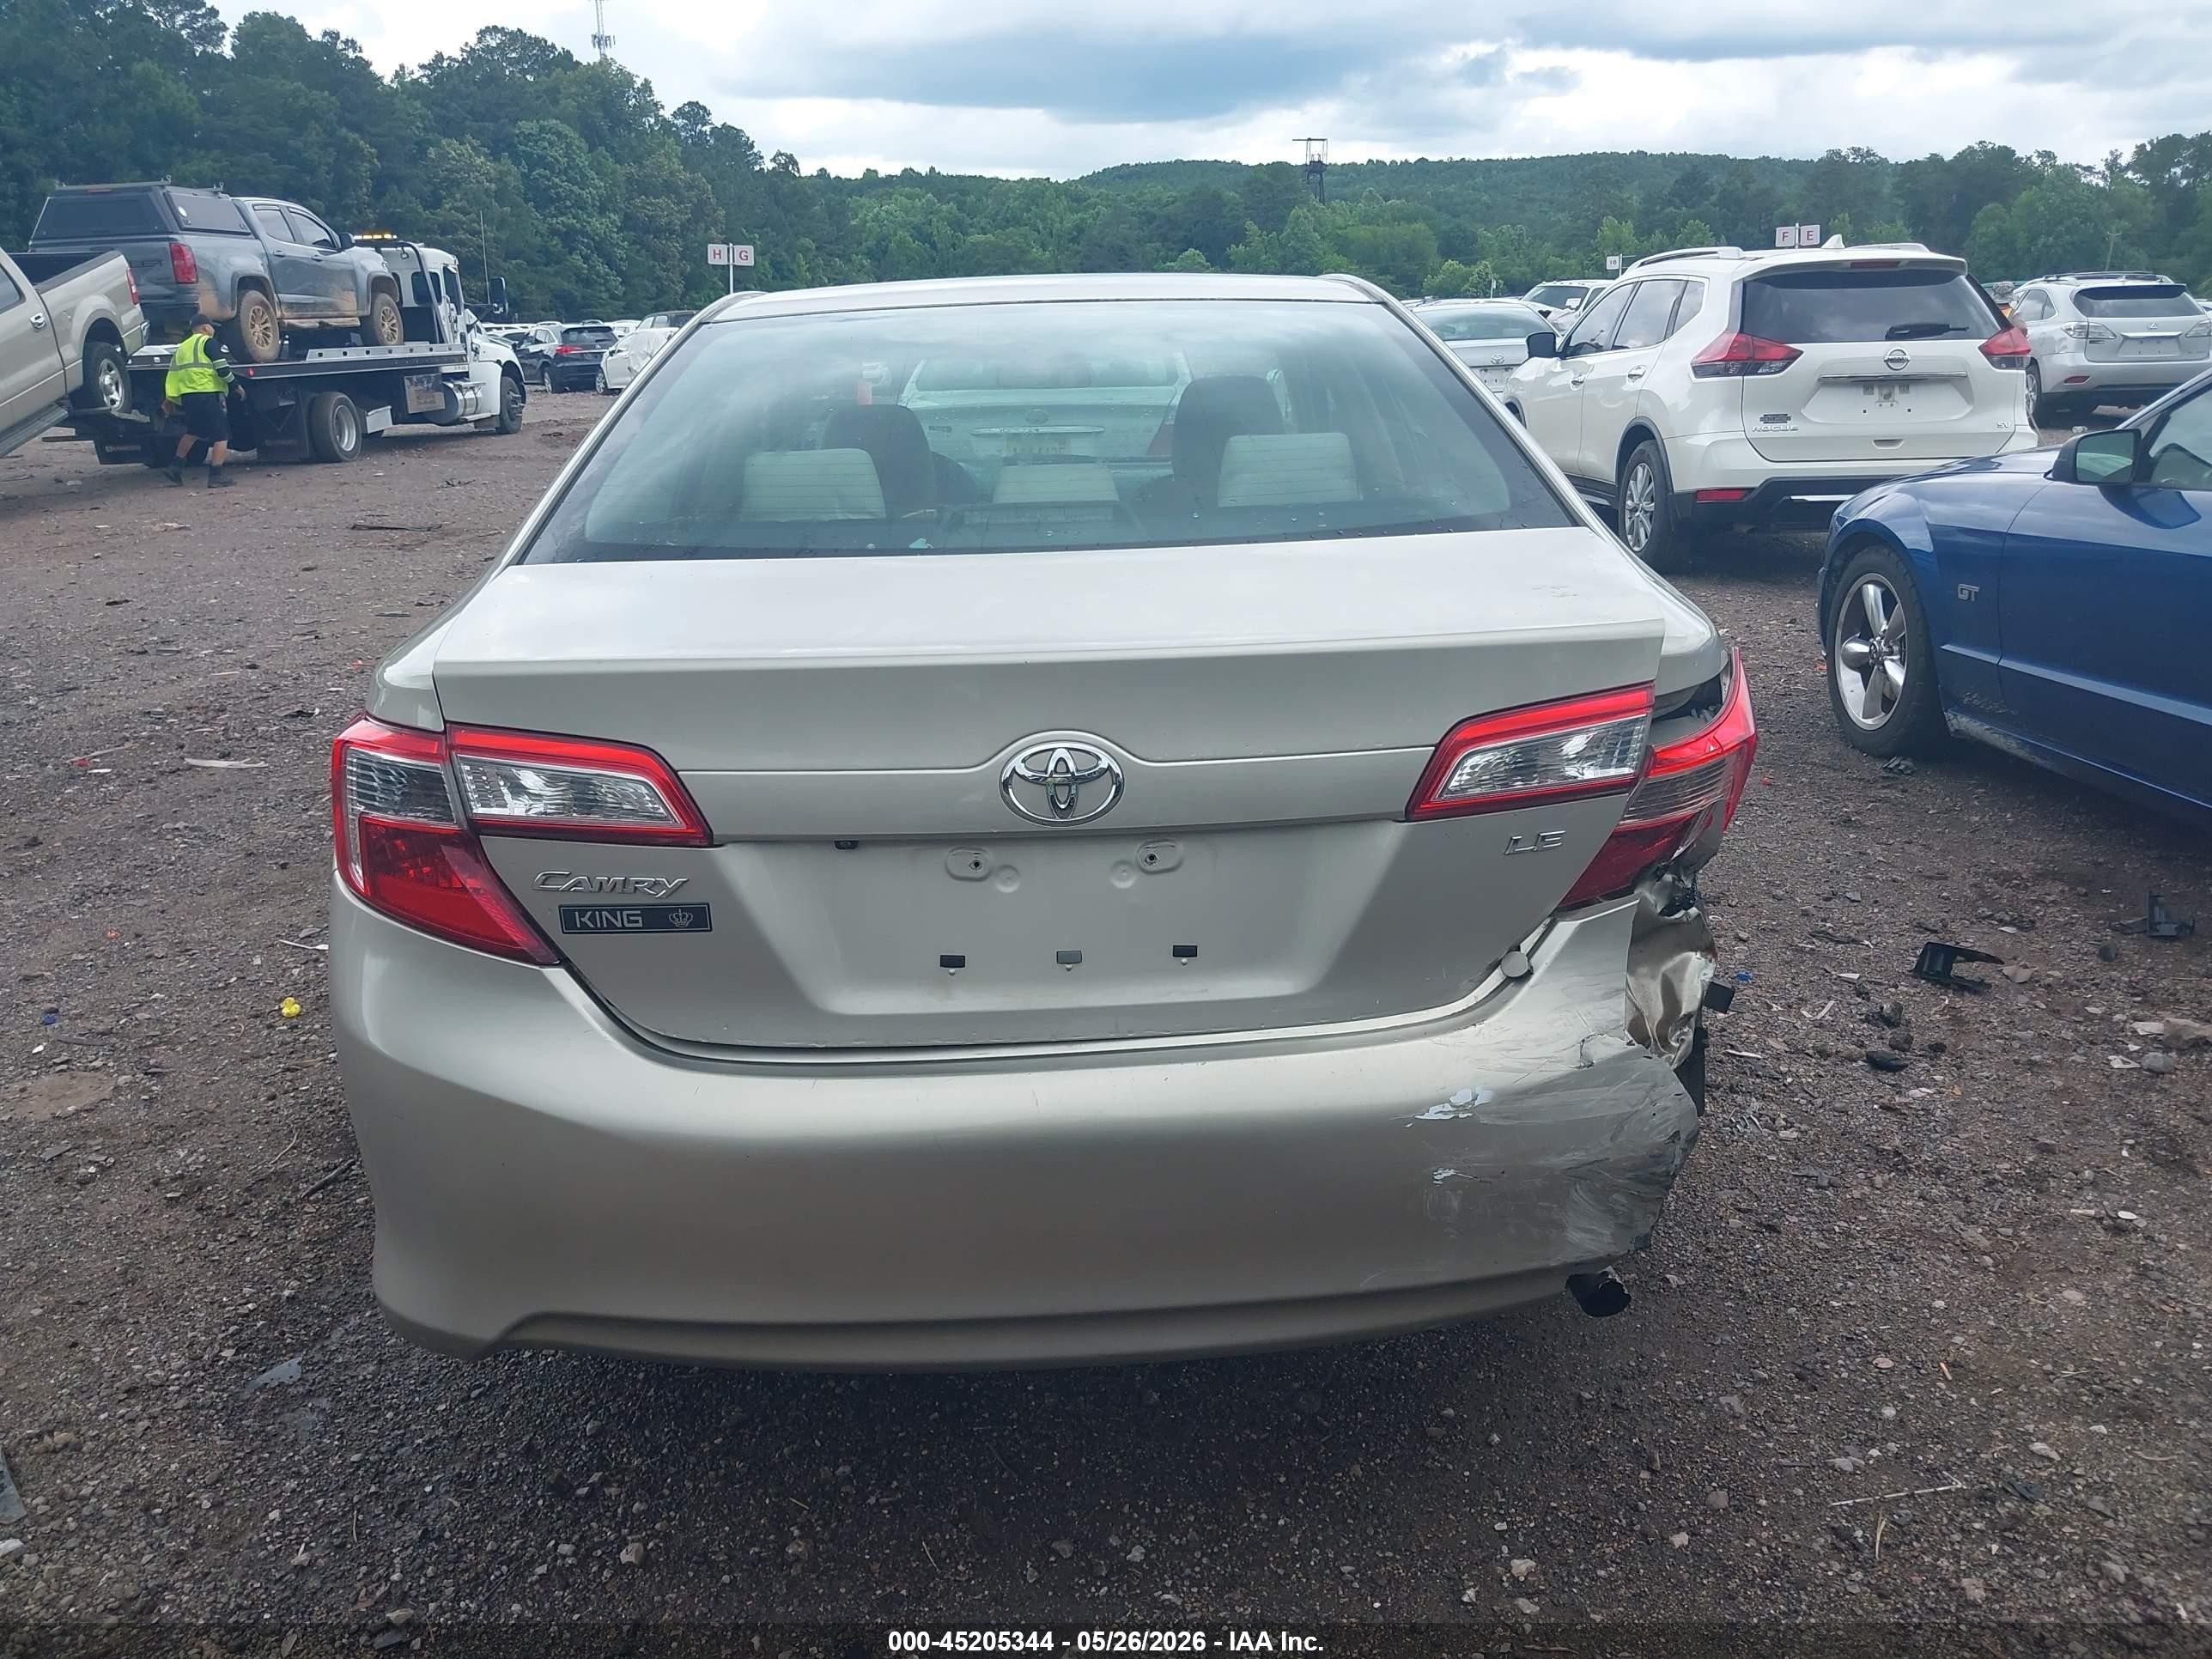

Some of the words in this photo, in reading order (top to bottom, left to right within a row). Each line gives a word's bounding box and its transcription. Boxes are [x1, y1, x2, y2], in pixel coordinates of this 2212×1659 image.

[1782, 231, 1789, 241] F
[1806, 230, 1814, 240] E
[713, 248, 721, 259] H
[739, 250, 749, 261] G
[1958, 583, 1979, 602] GT
[1504, 830, 1566, 855] LE
[532, 871, 690, 898] CAMRY
[574, 910, 643, 928] KING
